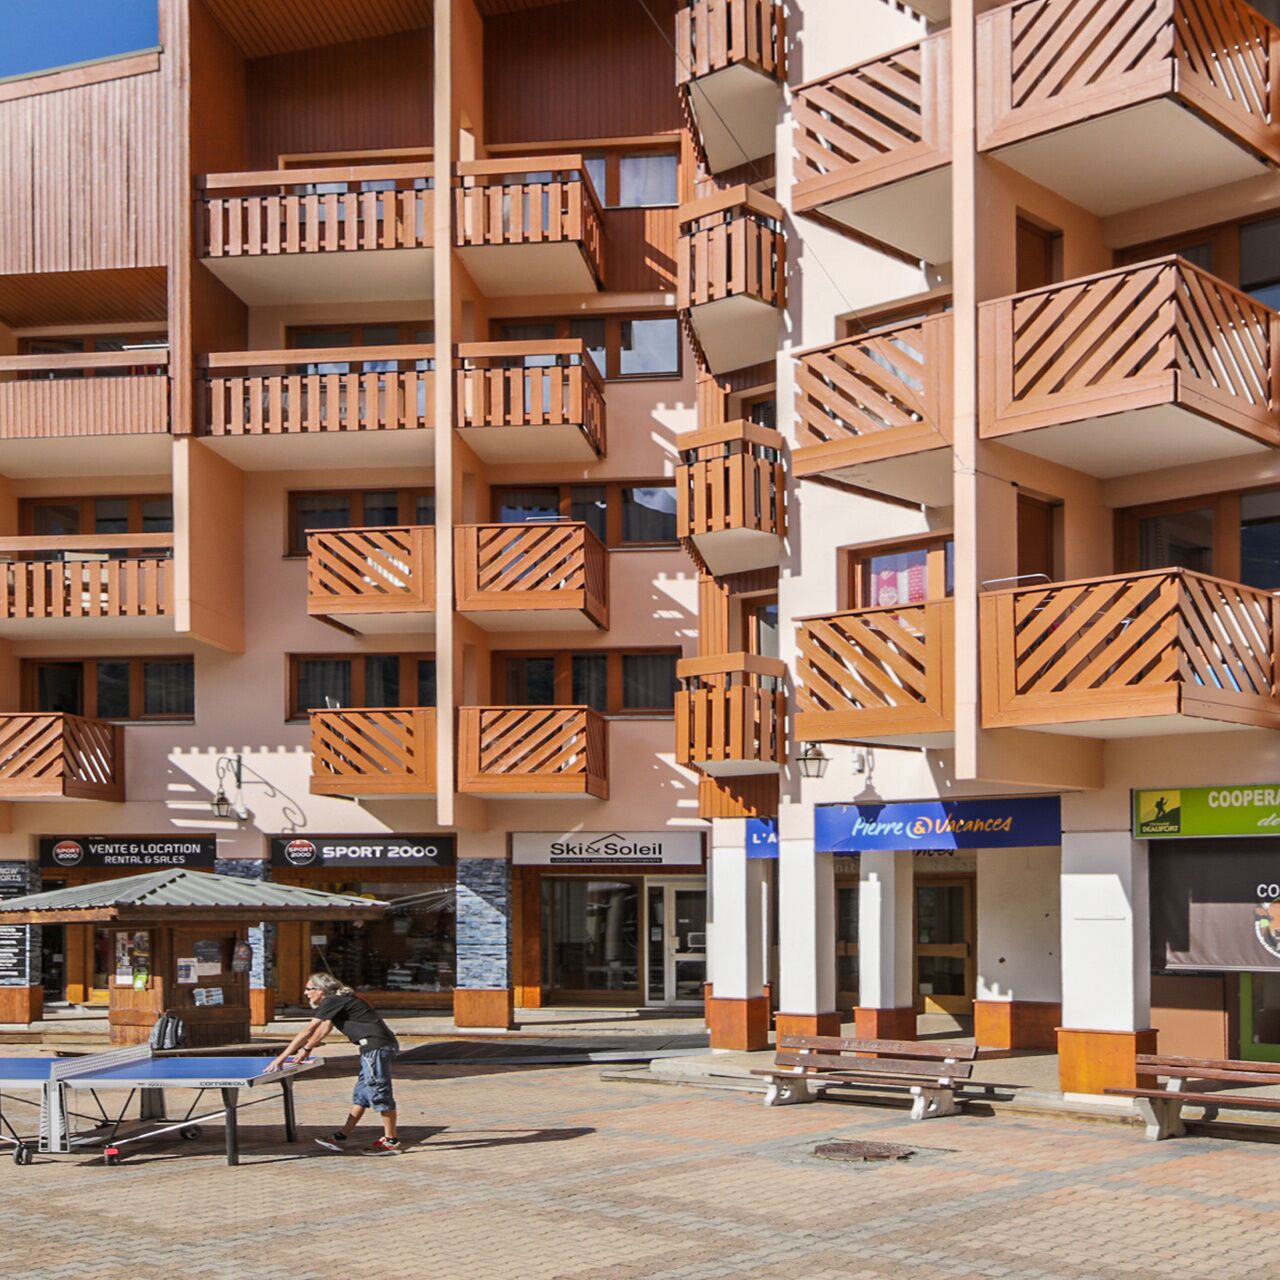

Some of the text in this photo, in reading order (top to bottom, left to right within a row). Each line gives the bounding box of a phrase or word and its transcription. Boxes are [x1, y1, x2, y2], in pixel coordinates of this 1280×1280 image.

[851, 813, 1013, 837] Pierre & Vacances
[89, 843, 201, 854] VENTE & LOCATION
[322, 846, 438, 858] SPORT 2000
[550, 842, 662, 855] Ski & Soleil
[104, 855, 185, 864] RENTAL & SALES
